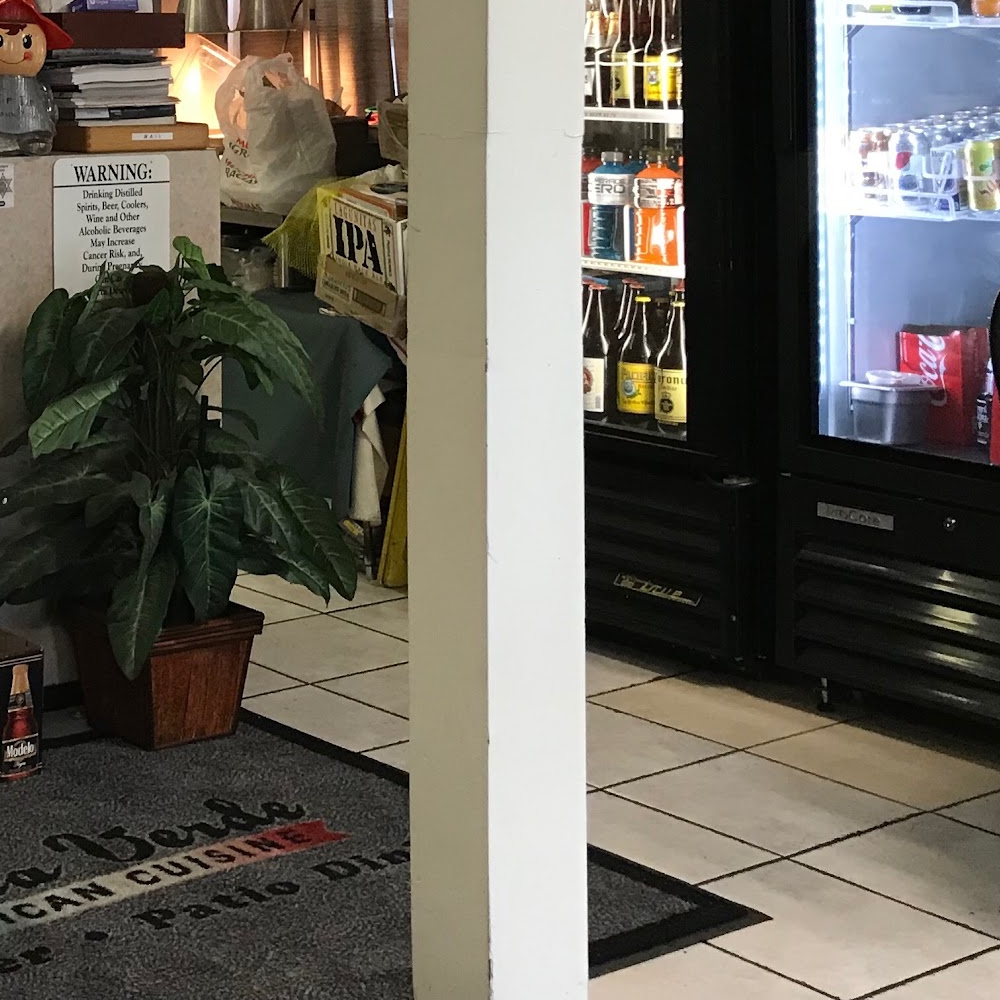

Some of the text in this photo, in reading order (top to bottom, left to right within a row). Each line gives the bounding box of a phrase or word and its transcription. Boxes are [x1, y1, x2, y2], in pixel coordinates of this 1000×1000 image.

[74, 164, 152, 182] WARNING:
[83, 187, 142, 199] Drinking Distilled
[77, 200, 148, 213] Spirits, Beer, Coolers,
[106, 213, 117, 222] and
[120, 212, 139, 221] Other
[79, 225, 146, 236] Alcoholic Beverages
[91, 238, 135, 248] May Increase
[333, 215, 383, 275] IPA
[83, 251, 107, 260] Cancer
[109, 250, 126, 258] Risk,
[6, 742, 35, 758] Modelo
[43, 799, 306, 863] Verde
[126, 829, 312, 886] CUISINE
[129, 880, 301, 929] Patio
